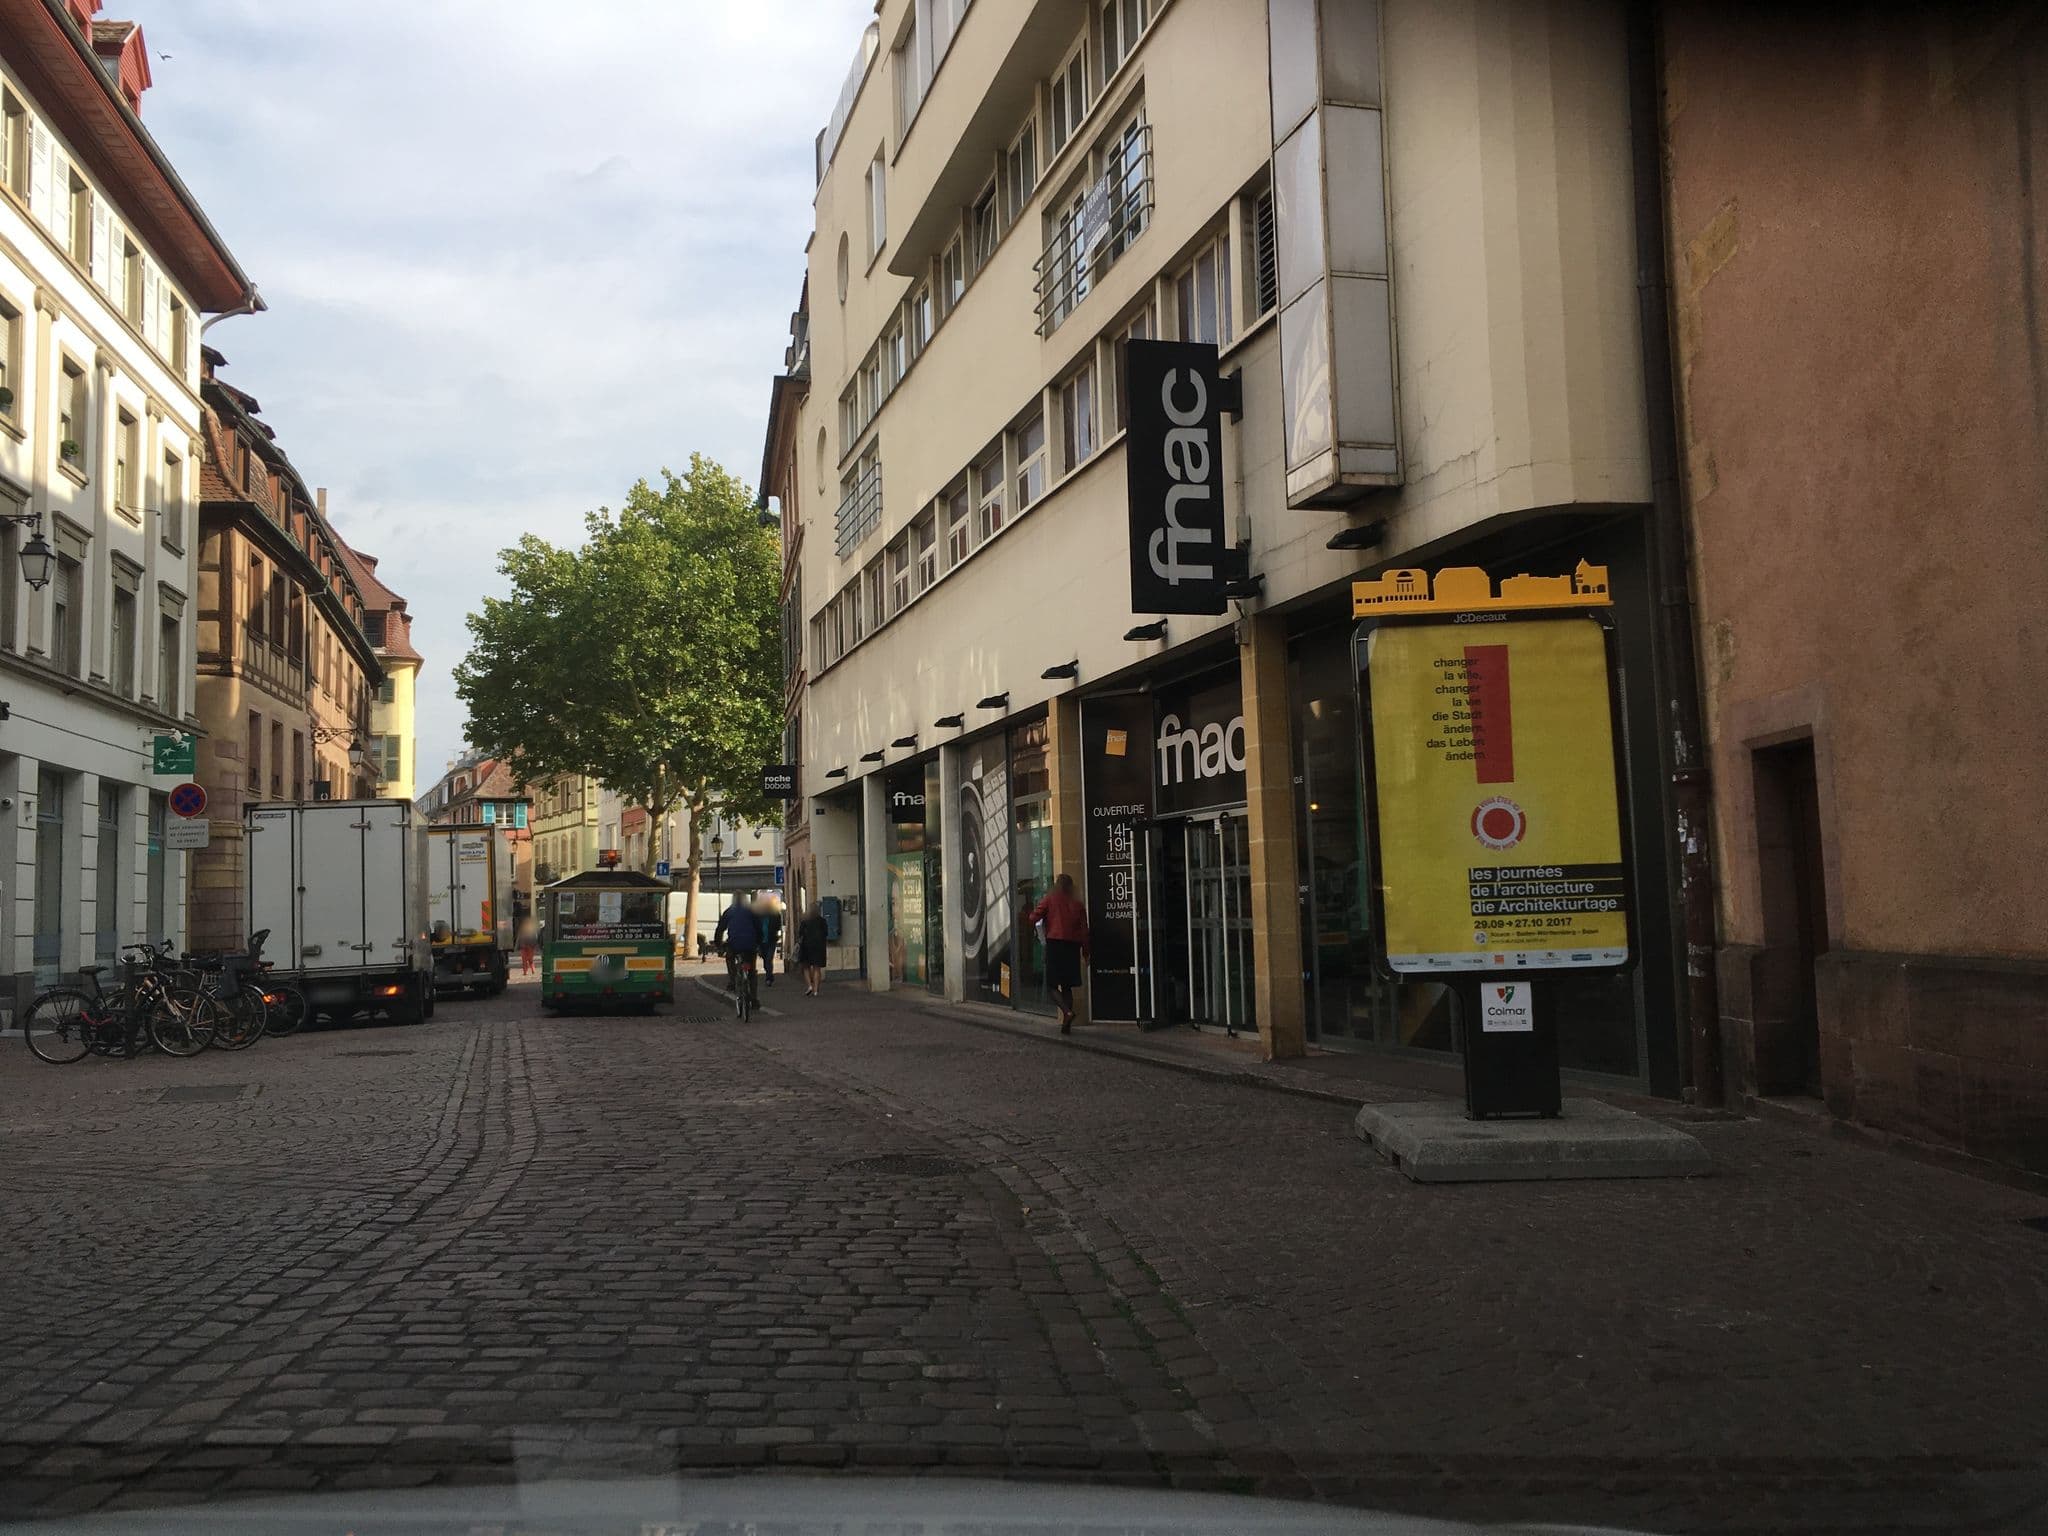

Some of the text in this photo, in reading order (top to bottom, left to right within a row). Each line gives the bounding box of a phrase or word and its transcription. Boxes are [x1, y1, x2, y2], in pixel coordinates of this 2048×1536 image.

[1149, 367, 1214, 586] fnac
[1453, 612, 1508, 624] JCDecaux
[1433, 658, 1479, 668] changer
[1444, 671, 1454, 680] la
[1435, 685, 1480, 695] changer
[1452, 697, 1482, 707] la vie
[1432, 711, 1482, 721] die Stadt
[1426, 738, 1485, 748] das Leben
[764, 774, 791, 783] roche
[764, 782, 792, 790] bobois
[892, 791, 925, 807] fna
[1093, 804, 1145, 817] OUVERTURE
[1106, 853, 1115, 861] LE
[1471, 865, 1563, 882] les journées
[1471, 882, 1594, 897] de l'architecture
[1106, 902, 1116, 910] DU
[1472, 898, 1618, 913] die Architekturtage
[1105, 911, 1115, 919] AU
[1514, 918, 1543, 928] 27.10
[1546, 917, 1573, 927] 2017
[1487, 1006, 1527, 1016] Colmar
